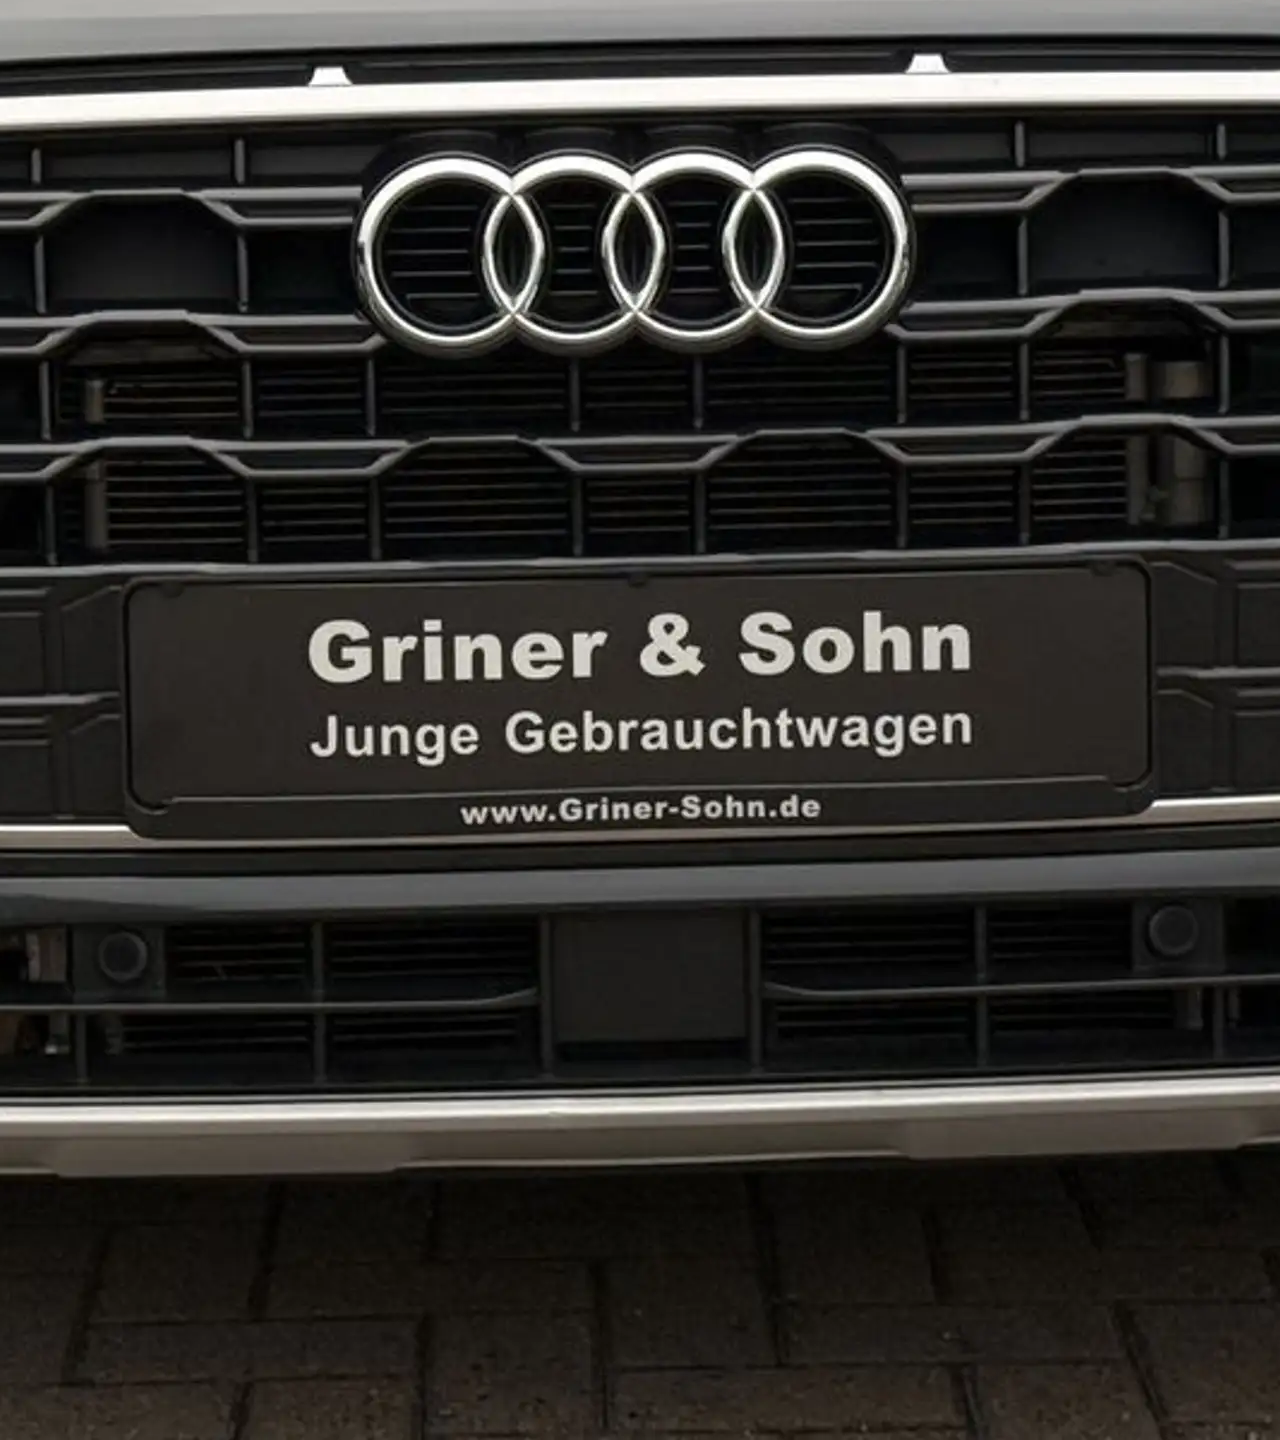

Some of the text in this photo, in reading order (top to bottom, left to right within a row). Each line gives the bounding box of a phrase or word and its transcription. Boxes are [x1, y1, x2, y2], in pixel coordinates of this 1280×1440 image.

[308, 610, 972, 683] Griner & Sohn
[310, 707, 973, 766] Junge Gebrauchtwagen
[460, 793, 822, 826] www.Griner-Sohn.de
